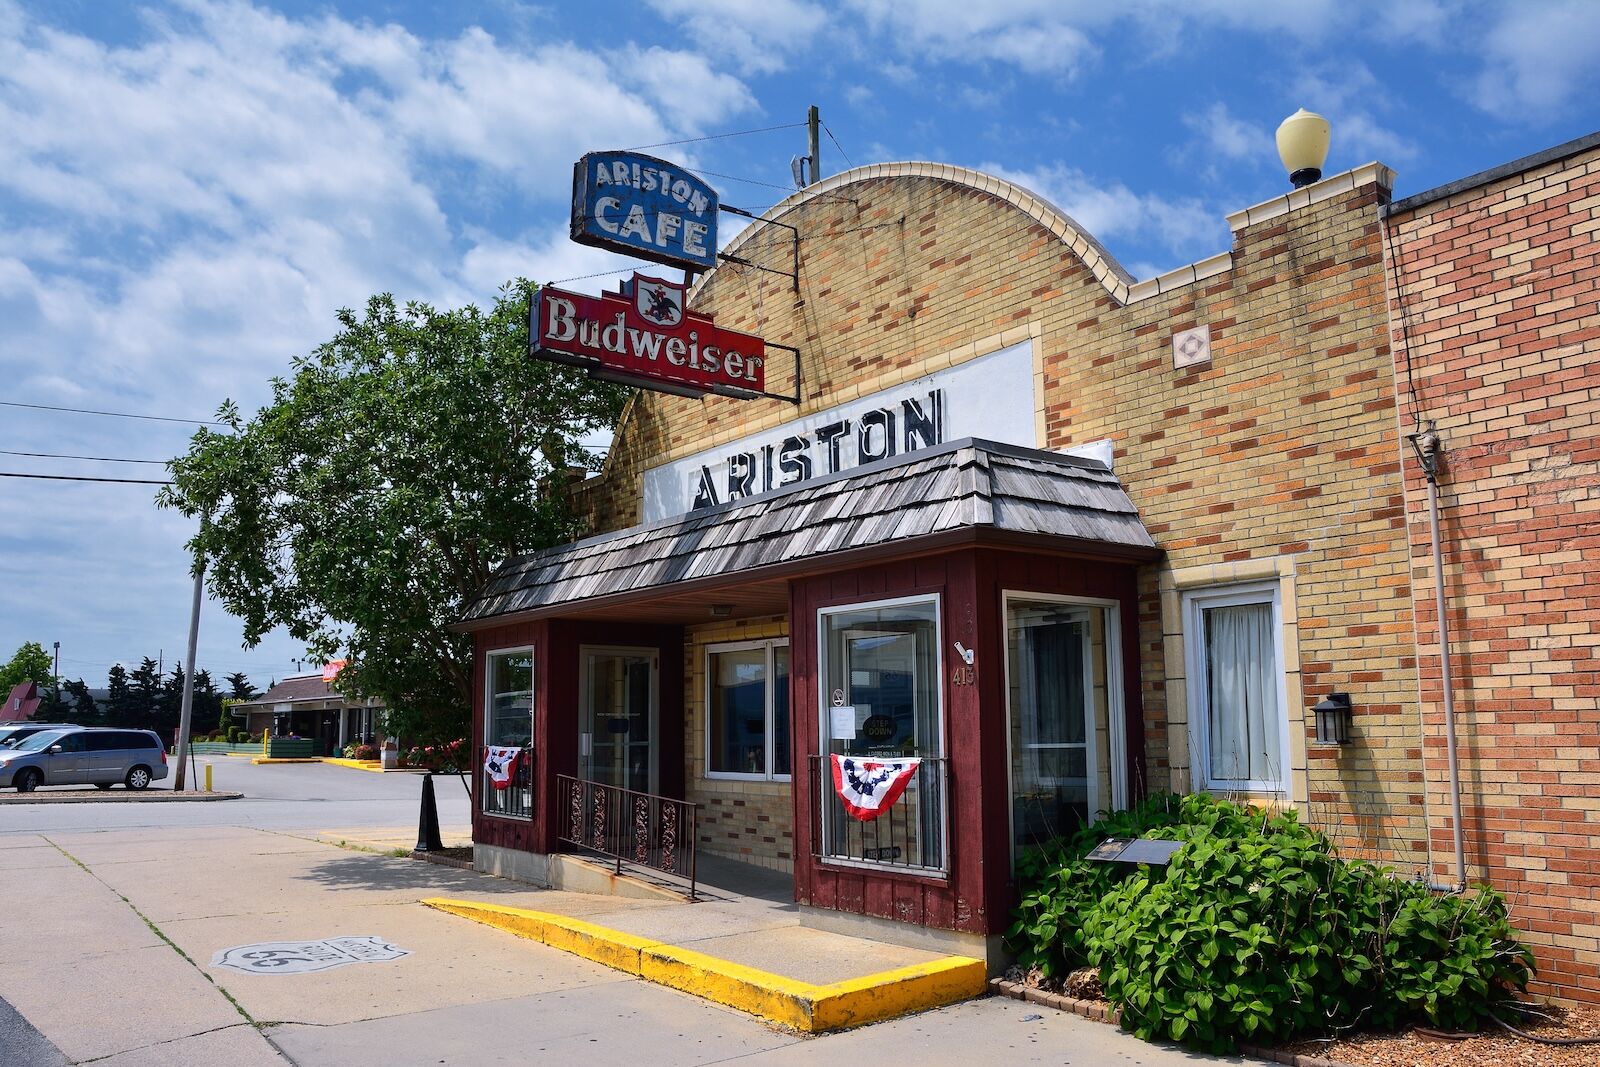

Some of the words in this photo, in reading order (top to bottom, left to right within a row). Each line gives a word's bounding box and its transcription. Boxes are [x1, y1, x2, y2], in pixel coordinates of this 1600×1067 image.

[596, 161, 709, 218] ARISTON
[594, 196, 708, 258] CAFE
[545, 296, 762, 381] Budweiser
[691, 388, 946, 511] ARISTON
[953, 667, 976, 685] 413
[868, 727, 892, 736] DOWN
[870, 719, 889, 728] STEP
[241, 950, 313, 967] 66
[298, 945, 343, 961] ROUTE
